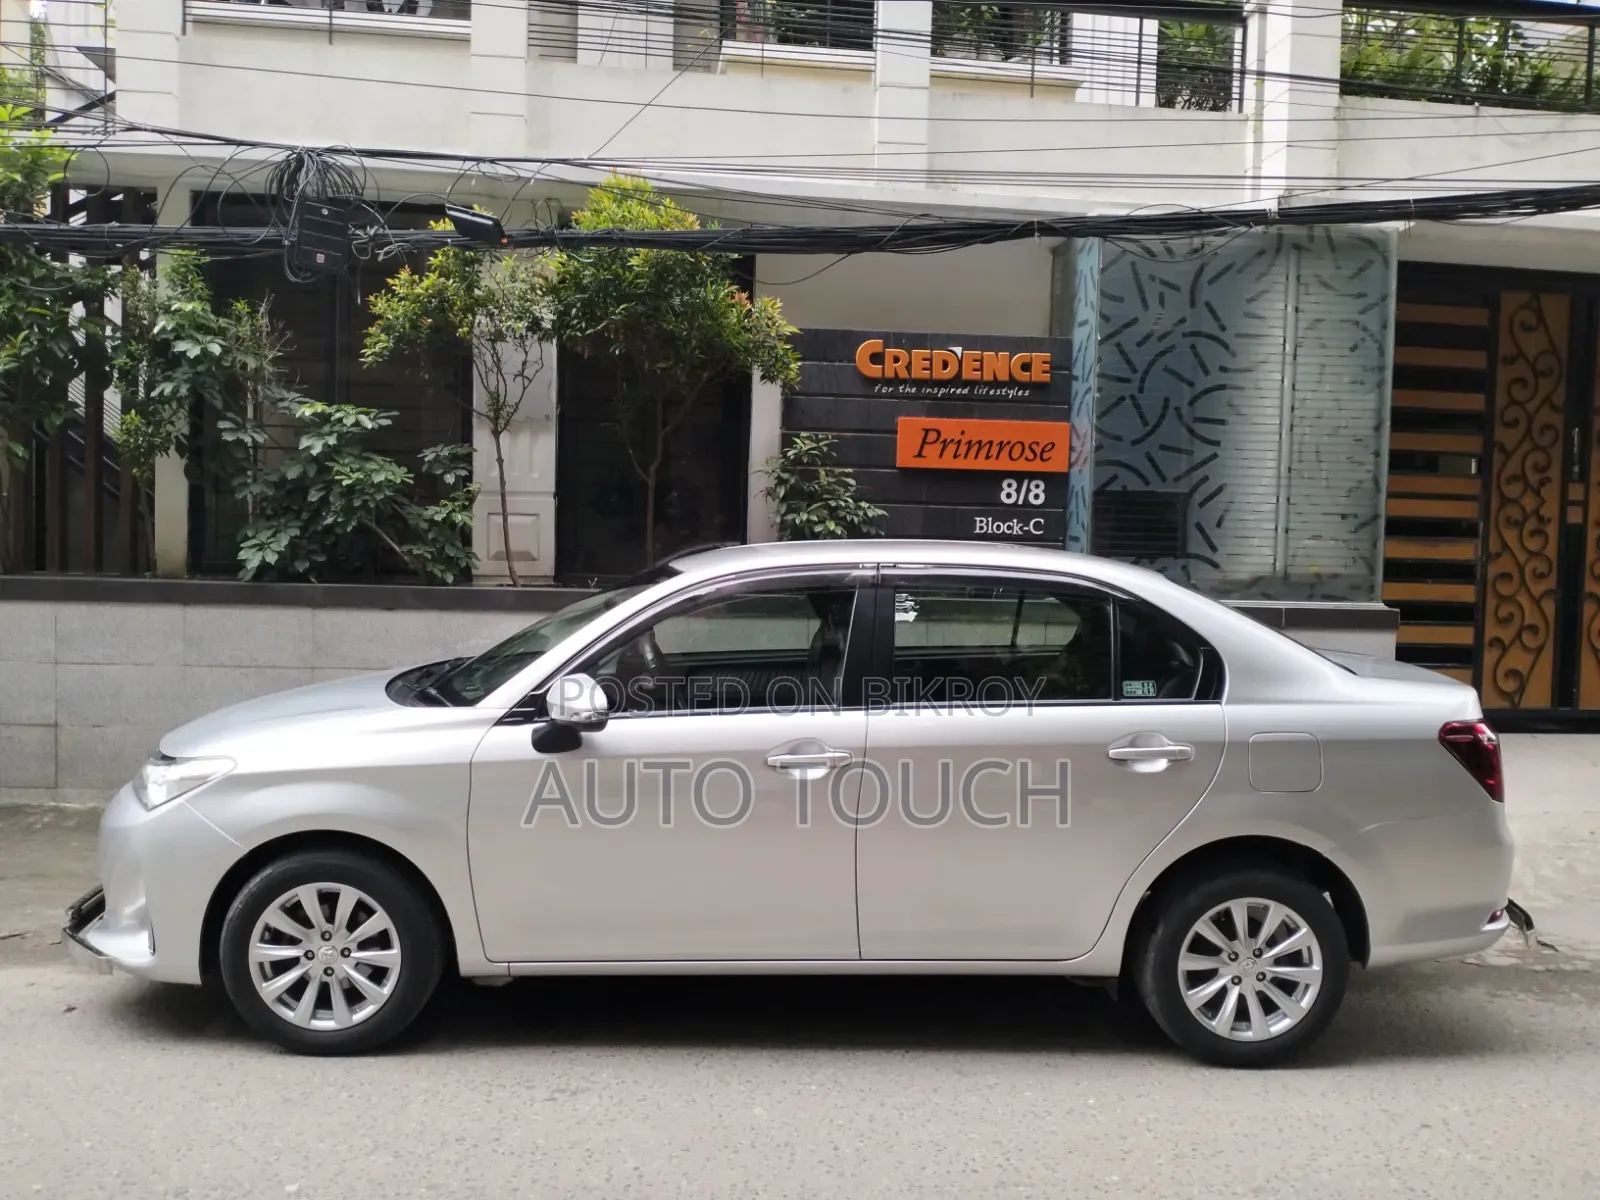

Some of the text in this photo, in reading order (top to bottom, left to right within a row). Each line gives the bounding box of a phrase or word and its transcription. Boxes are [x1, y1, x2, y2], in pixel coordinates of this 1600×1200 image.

[874, 384, 1032, 399] for the inspired lifestyles
[913, 428, 1056, 463] Primrose
[1000, 478, 1046, 505] 8/8
[974, 517, 1044, 535] Block-C
